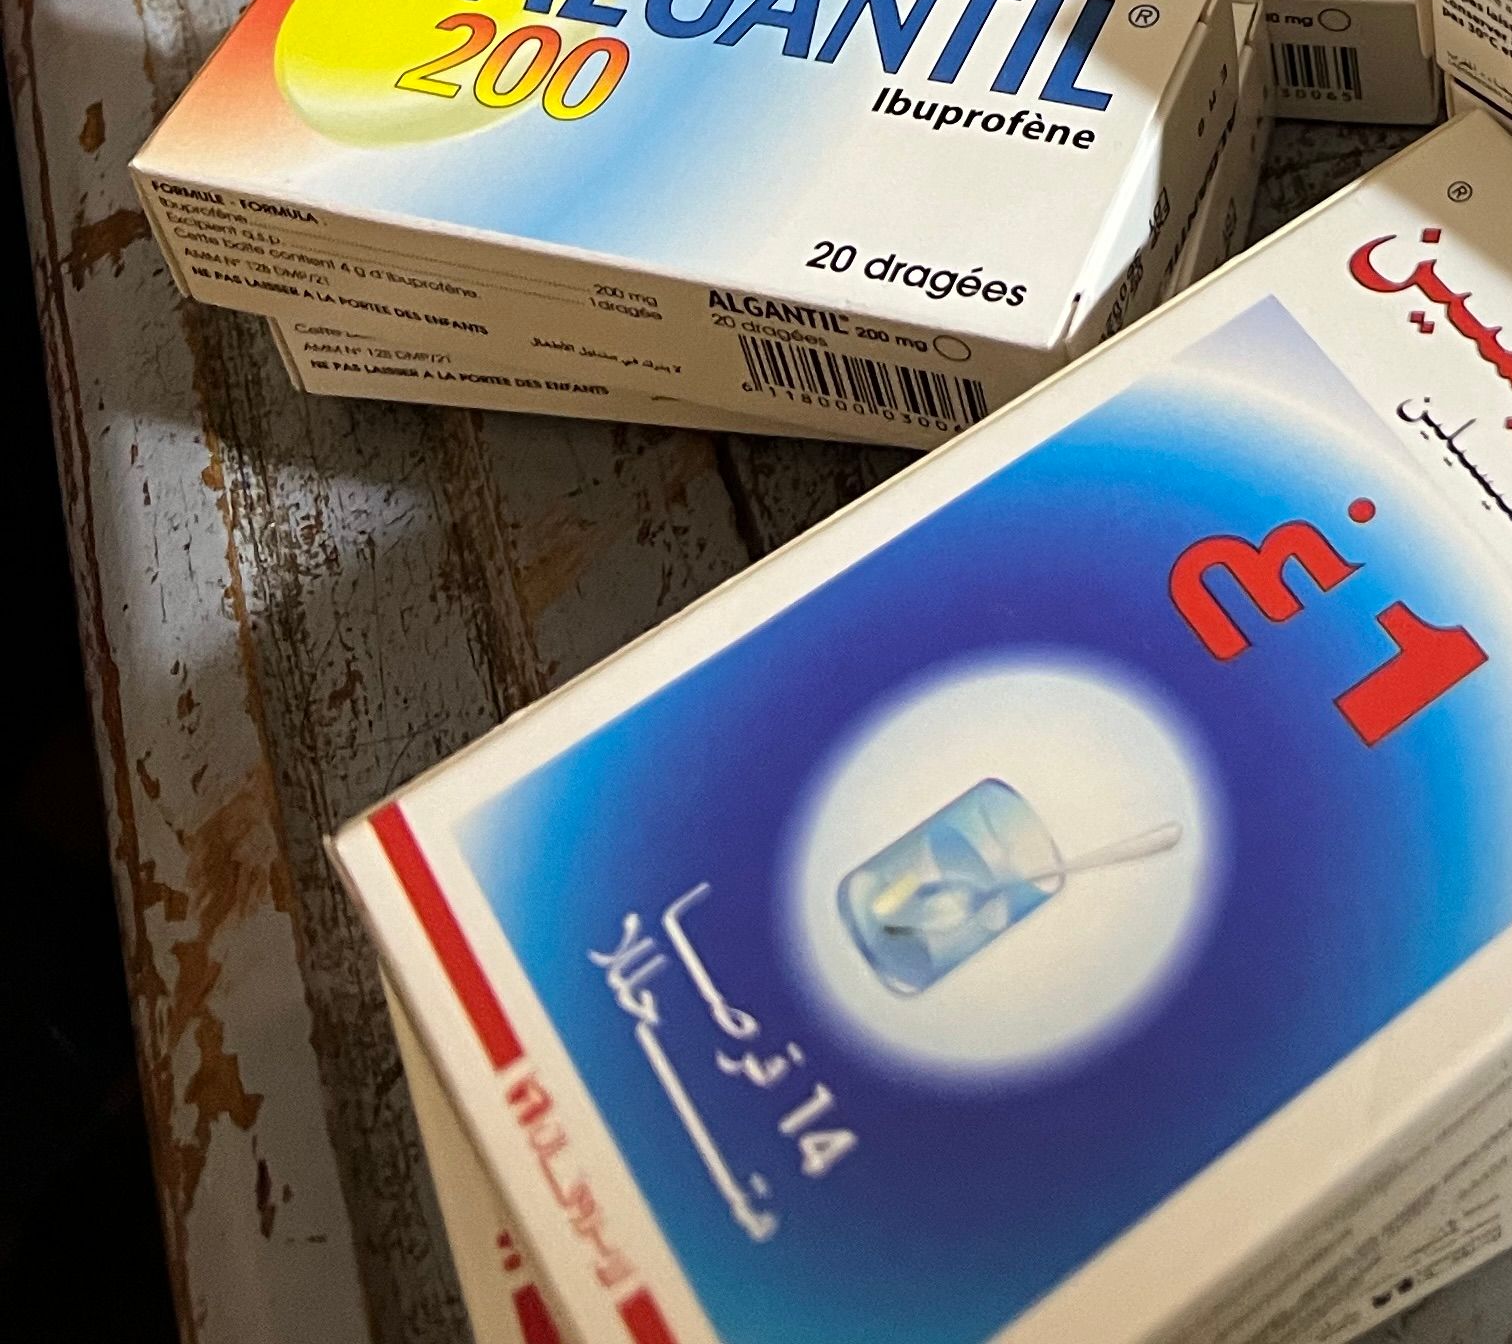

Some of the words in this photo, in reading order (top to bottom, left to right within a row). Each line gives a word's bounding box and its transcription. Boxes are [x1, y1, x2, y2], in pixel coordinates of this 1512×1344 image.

[396, 13, 630, 122] 200
[870, 87, 1097, 151] Ibuprofène
[173, 226, 219, 246] Cette
[593, 284, 624, 299] 200
[806, 240, 854, 274] 20
[862, 252, 1028, 311] dragées
[711, 313, 736, 328] 20
[741, 321, 828, 347] dragées
[855, 326, 889, 342] 200
[895, 336, 928, 353] mg
[1332, 599, 1490, 750] 1
[774, 1084, 860, 1185] 14
